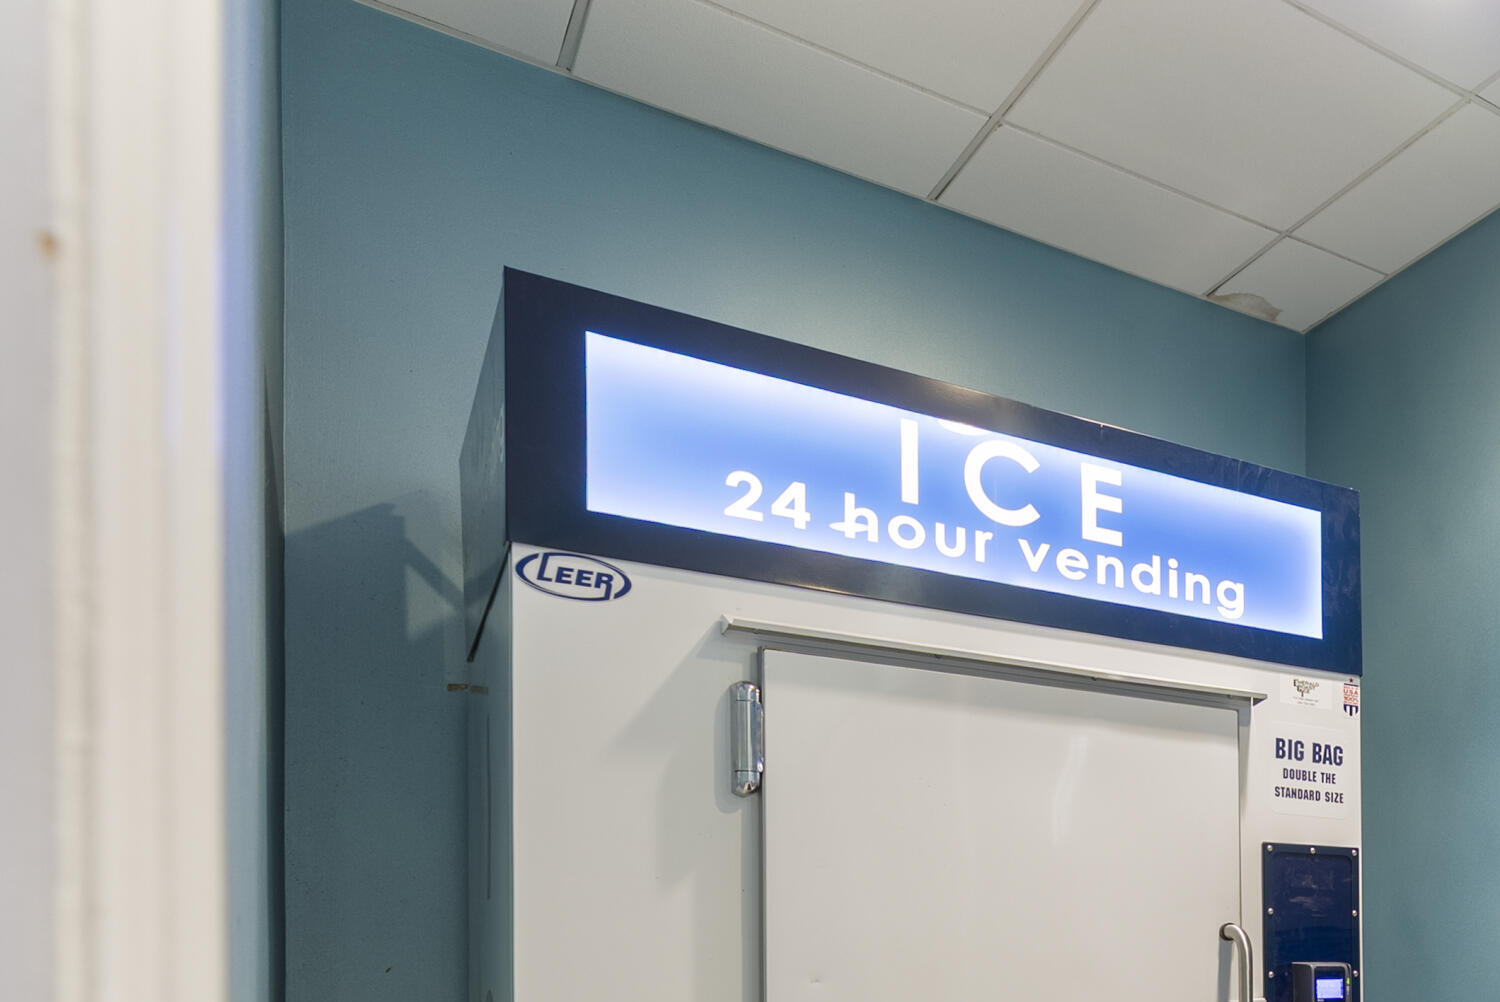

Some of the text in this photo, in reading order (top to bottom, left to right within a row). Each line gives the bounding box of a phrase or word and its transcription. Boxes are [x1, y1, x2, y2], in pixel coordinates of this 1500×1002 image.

[899, 419, 1124, 547] ICE
[723, 471, 1247, 618] 24 hour vending
[536, 552, 615, 601] LEER
[1275, 737, 1344, 767] BIG BAG
[1274, 786, 1344, 804] STANDARD SIZE
[1282, 768, 1336, 784] DOUBLE THE
